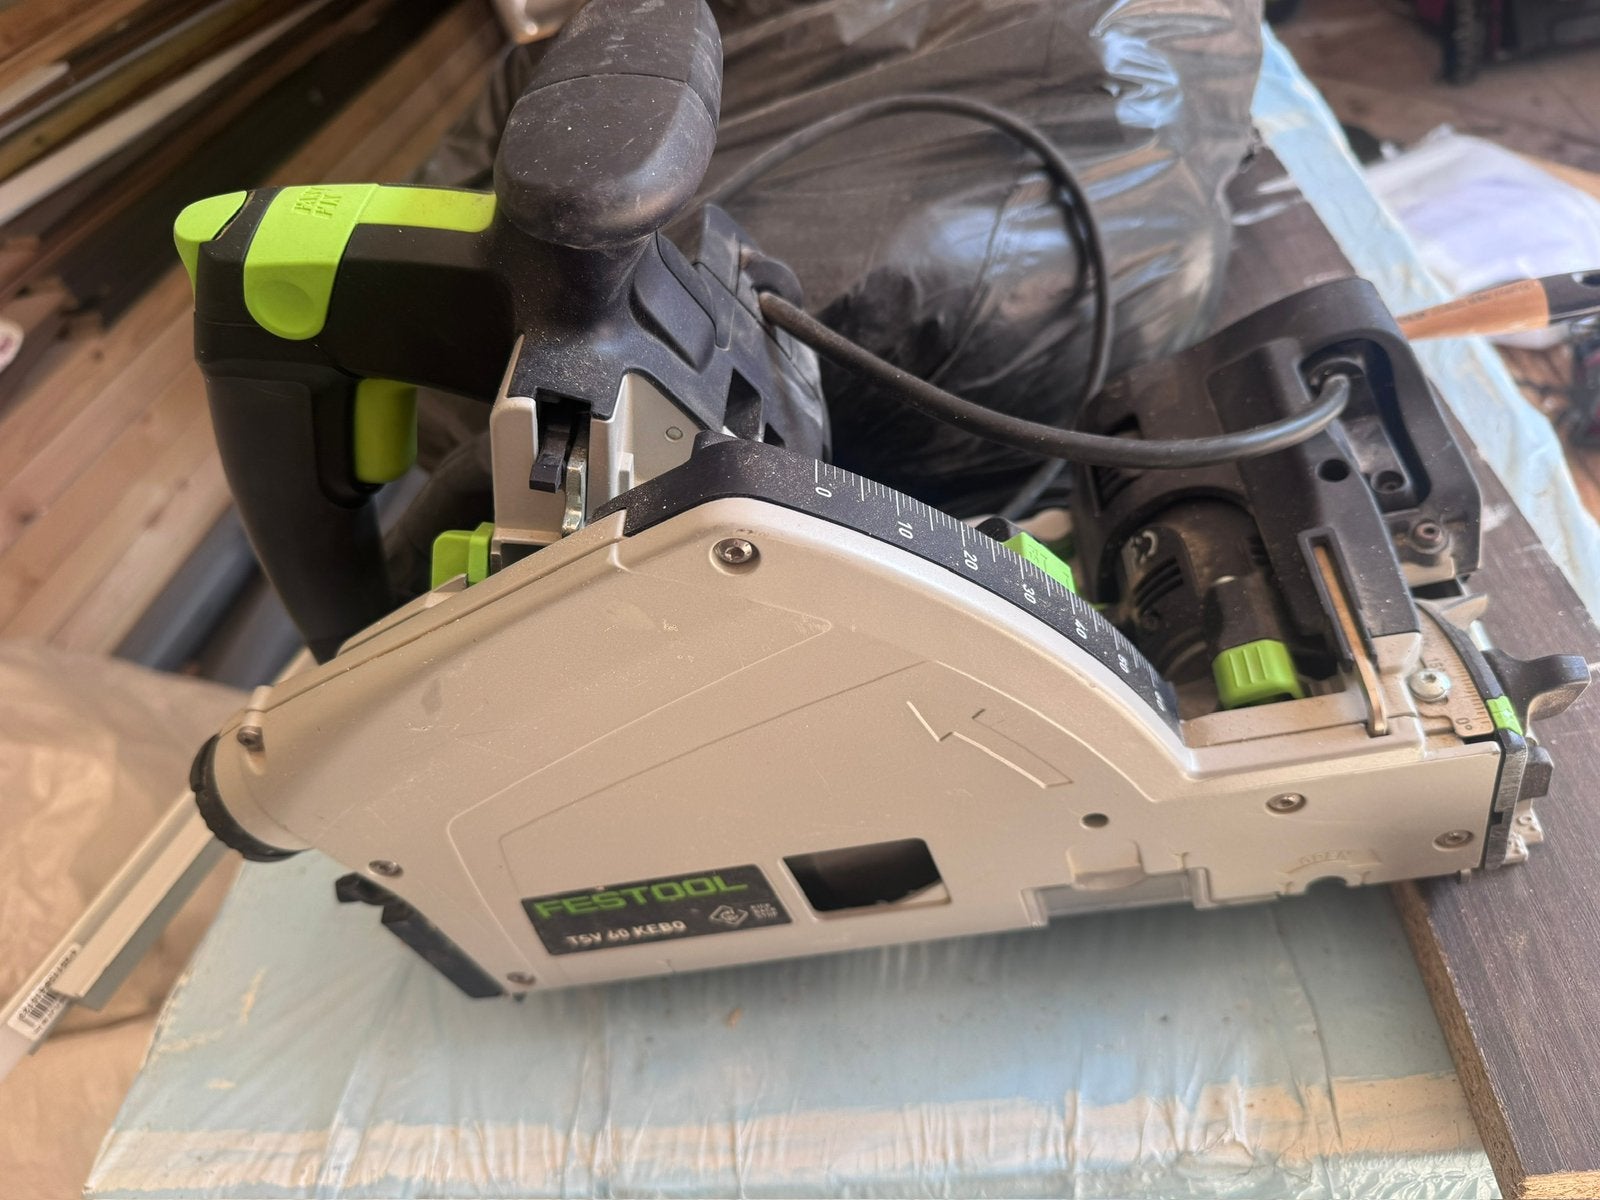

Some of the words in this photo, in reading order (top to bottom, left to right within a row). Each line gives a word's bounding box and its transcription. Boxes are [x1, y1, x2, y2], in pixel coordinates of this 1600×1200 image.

[815, 486, 832, 498] 0
[897, 520, 914, 540] 10
[963, 549, 979, 571] 20
[1022, 583, 1037, 604] 30
[1075, 618, 1088, 640] 40
[533, 874, 748, 920] FESTOOL
[566, 931, 604, 948] TSV
